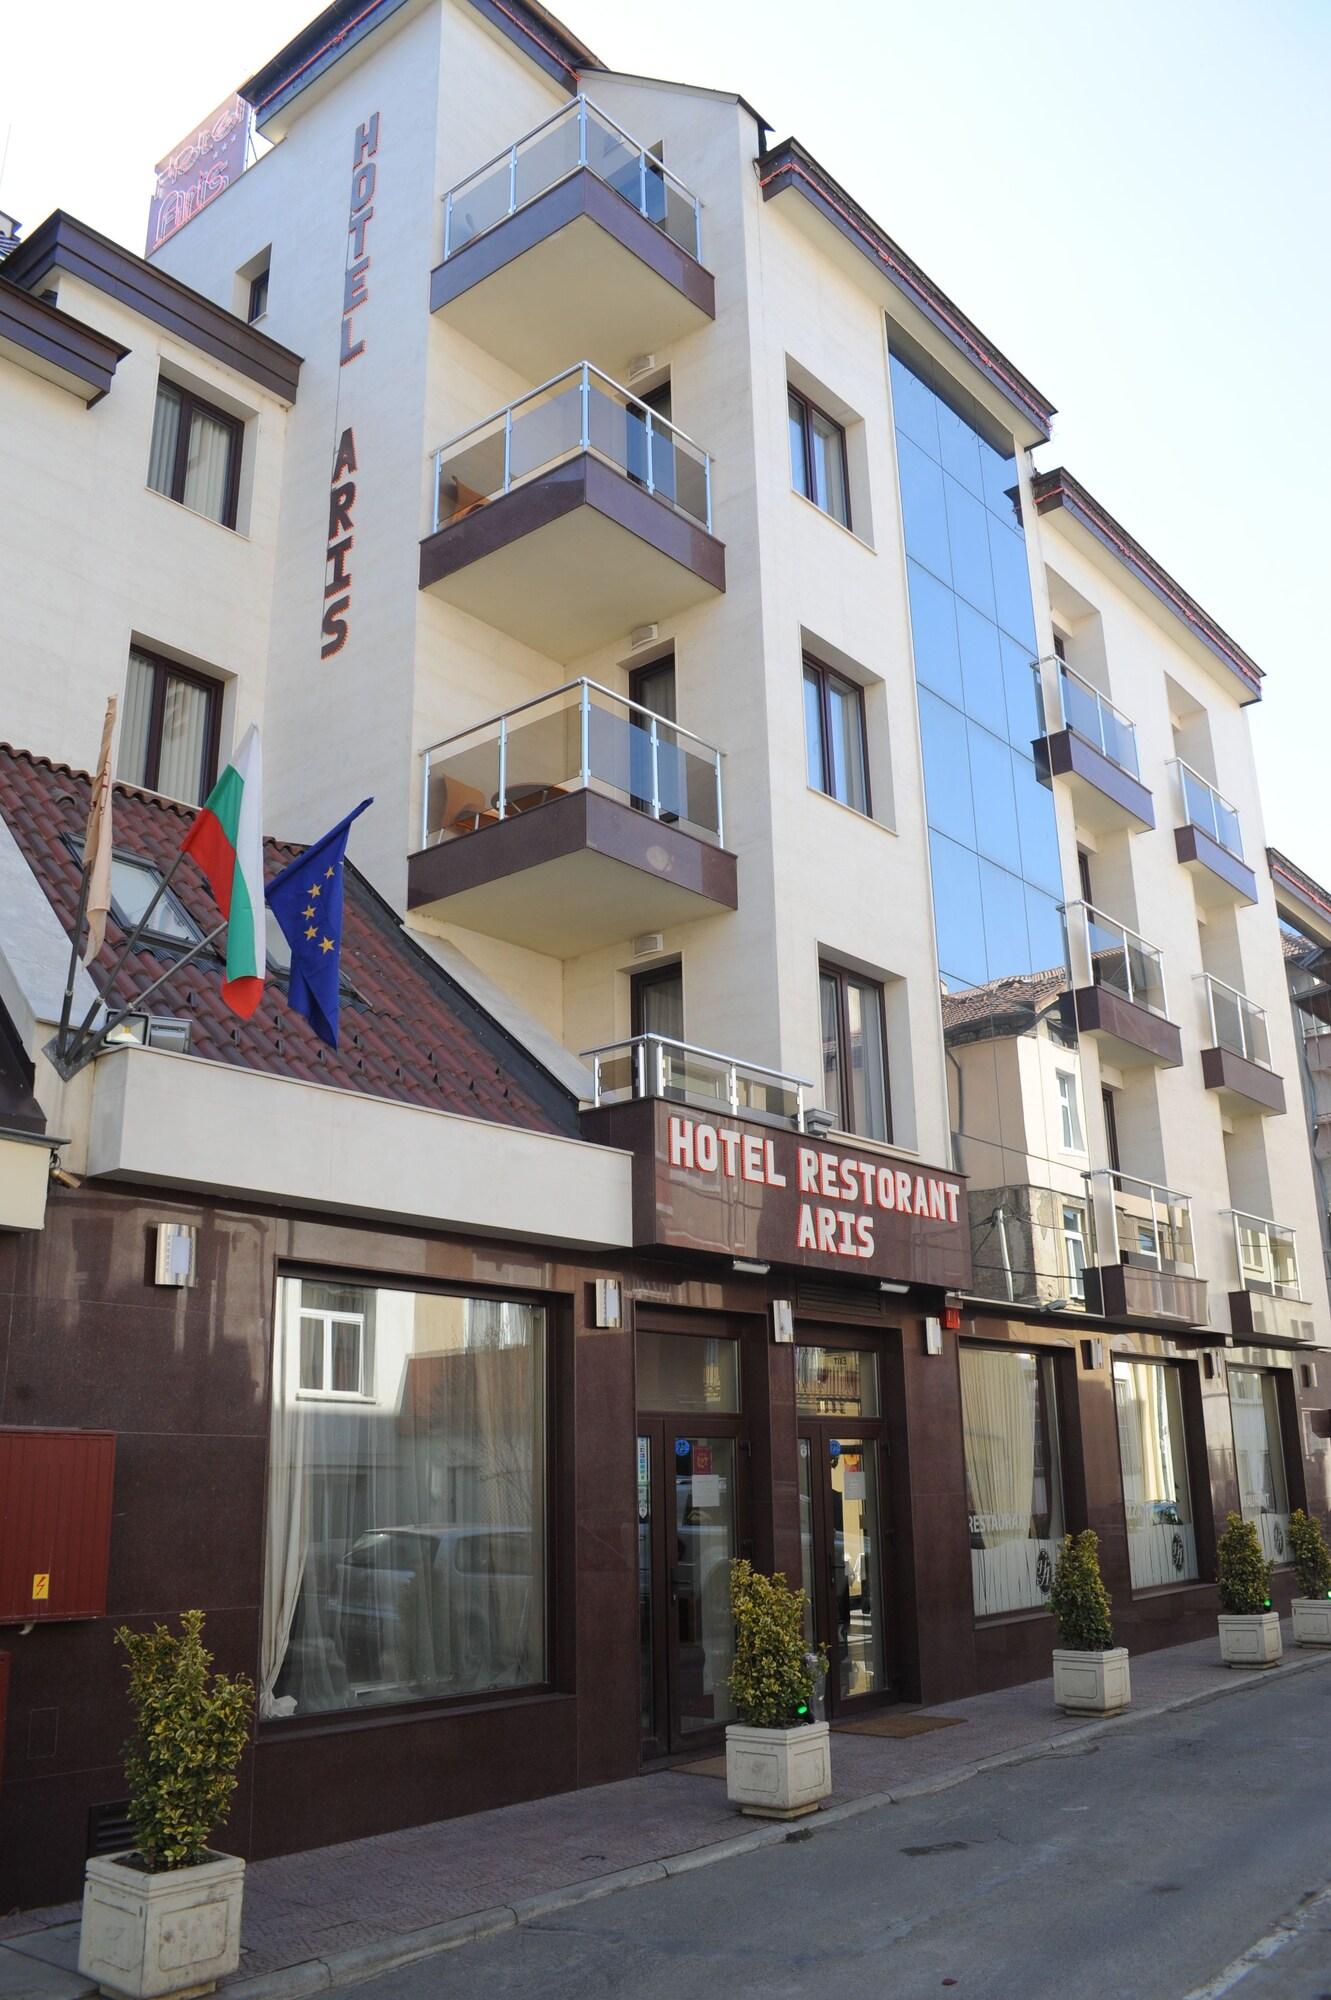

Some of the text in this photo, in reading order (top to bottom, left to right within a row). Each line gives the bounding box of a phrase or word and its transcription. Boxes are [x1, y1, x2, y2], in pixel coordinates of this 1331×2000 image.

[321, 111, 381, 660] HOTEL ARIS
[668, 1116, 960, 1222] HOTEL RESTORANT
[797, 1203, 875, 1258] ARIS
[968, 1511, 1029, 1533] RESTAURAN
